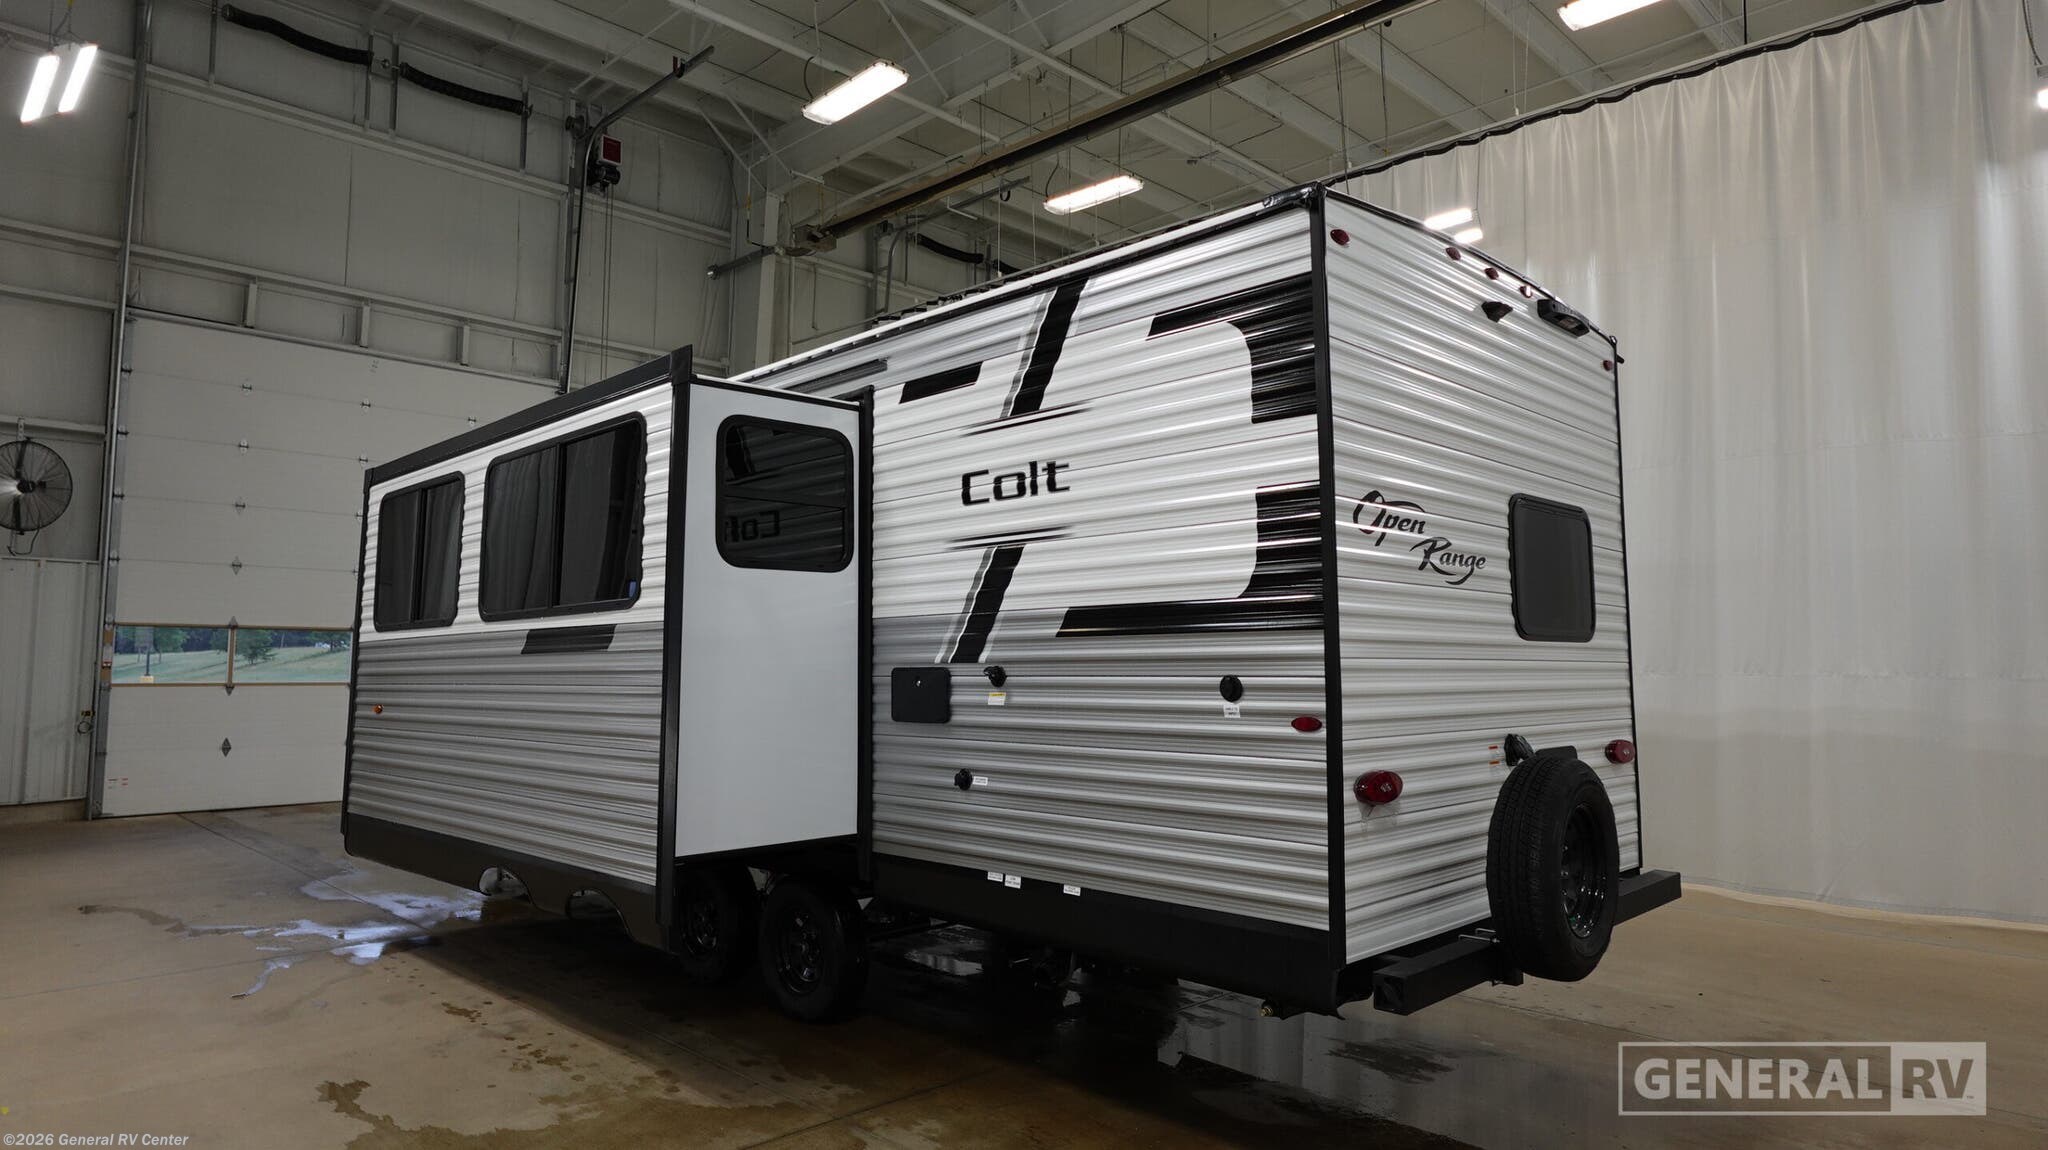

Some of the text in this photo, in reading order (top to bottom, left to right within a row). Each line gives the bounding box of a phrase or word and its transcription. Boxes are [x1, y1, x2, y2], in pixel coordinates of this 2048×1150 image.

[961, 460, 1070, 506] Colt
[1353, 490, 1426, 547] Open
[1409, 536, 1487, 585] Range
